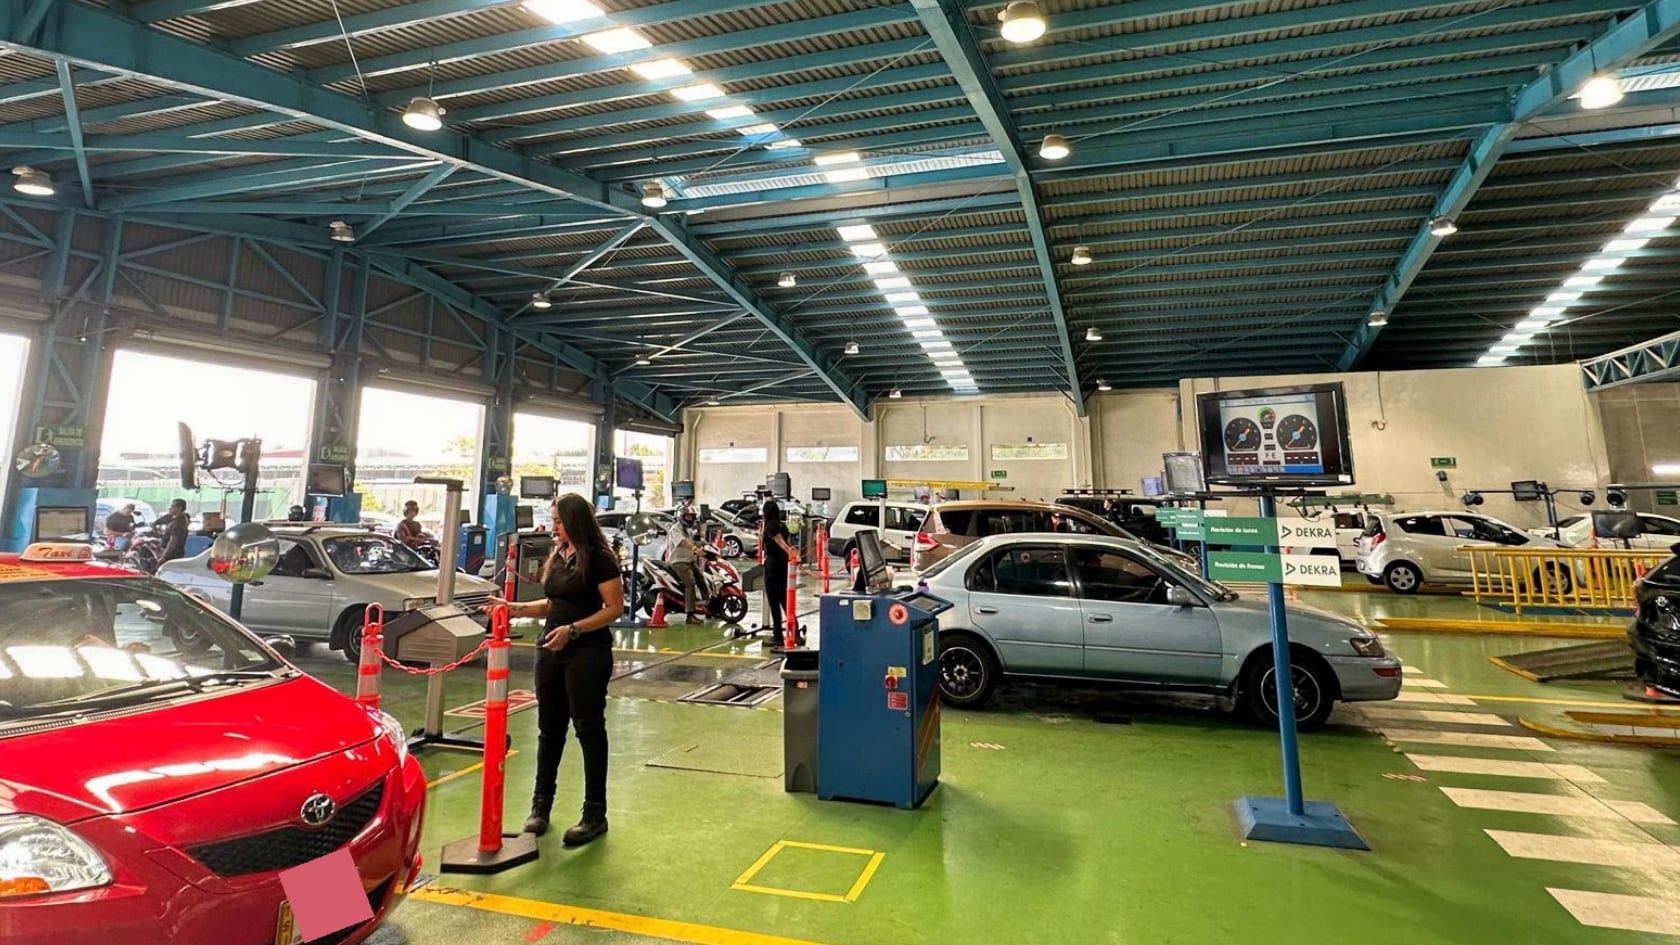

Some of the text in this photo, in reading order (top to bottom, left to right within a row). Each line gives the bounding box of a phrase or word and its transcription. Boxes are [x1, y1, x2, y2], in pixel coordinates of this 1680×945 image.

[1296, 527, 1333, 538] DEKRA
[1214, 561, 1238, 569] Revisión
[1300, 564, 1337, 576] DEKRA
